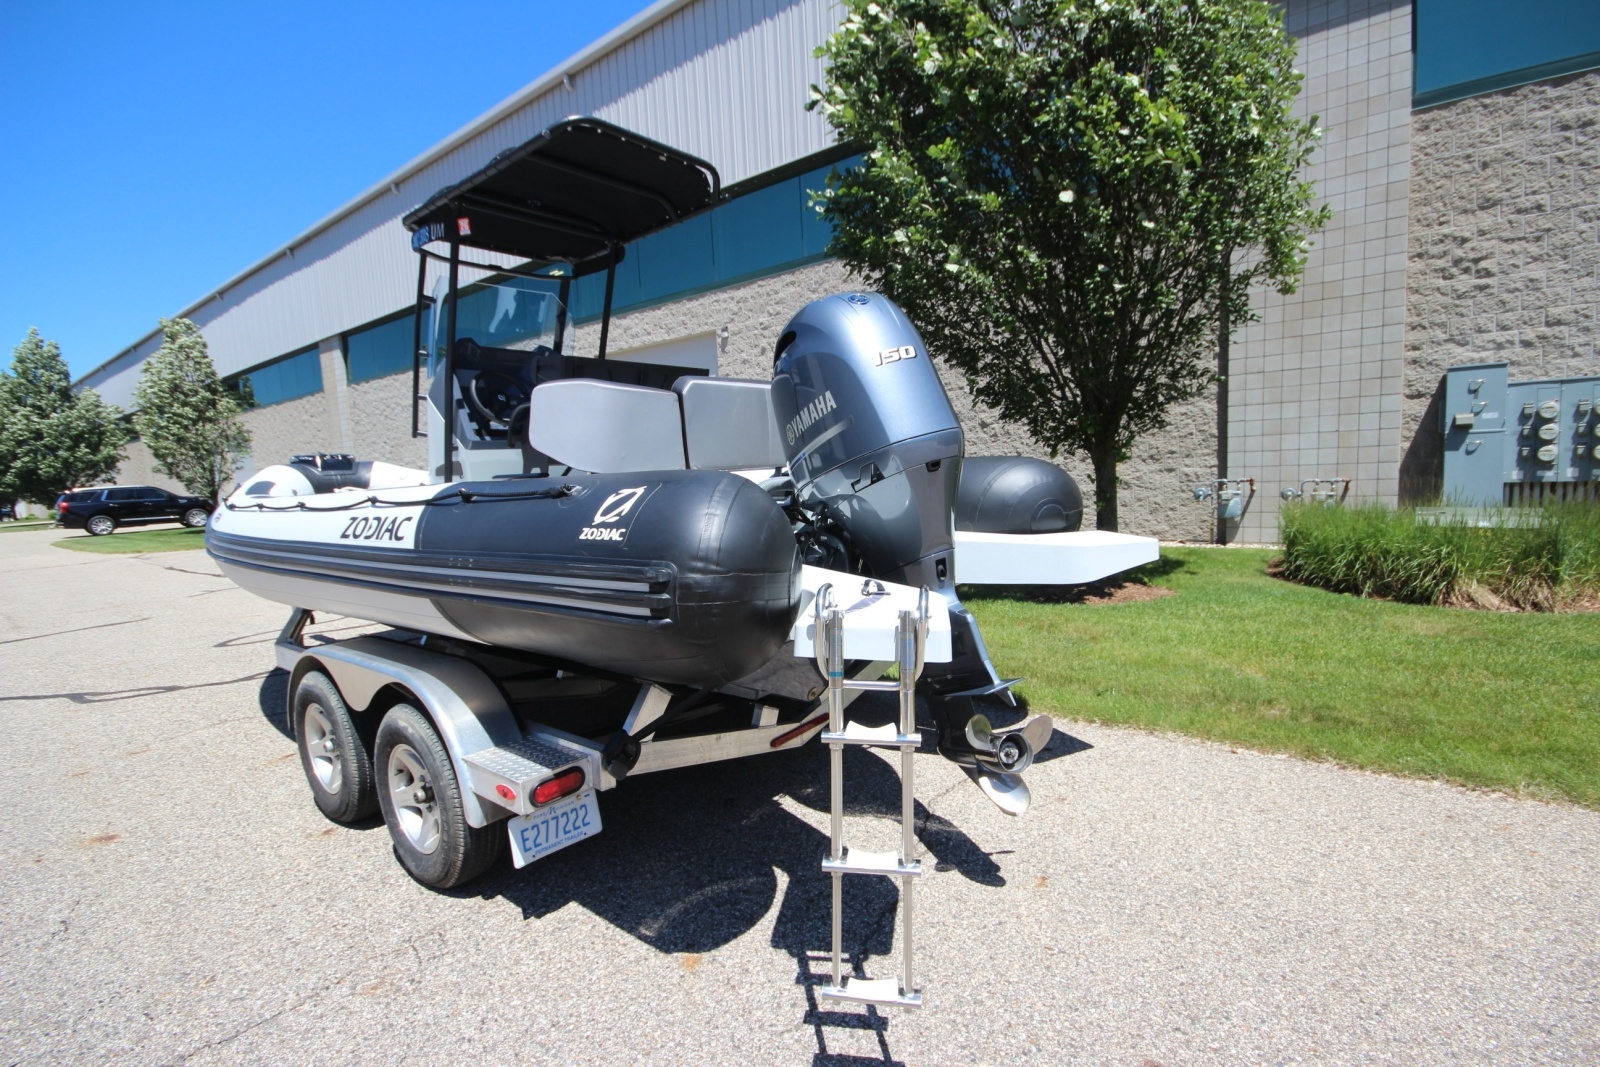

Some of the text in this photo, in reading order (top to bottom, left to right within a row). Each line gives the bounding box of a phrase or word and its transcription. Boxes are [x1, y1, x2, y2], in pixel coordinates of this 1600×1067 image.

[871, 345, 917, 367] 150
[791, 390, 837, 438] YAMAHA
[340, 516, 413, 541] ZODIAC
[578, 527, 626, 541] ZODIAC
[520, 804, 590, 853] E277222
[535, 831, 584, 855] PERMANENT TRAILER
